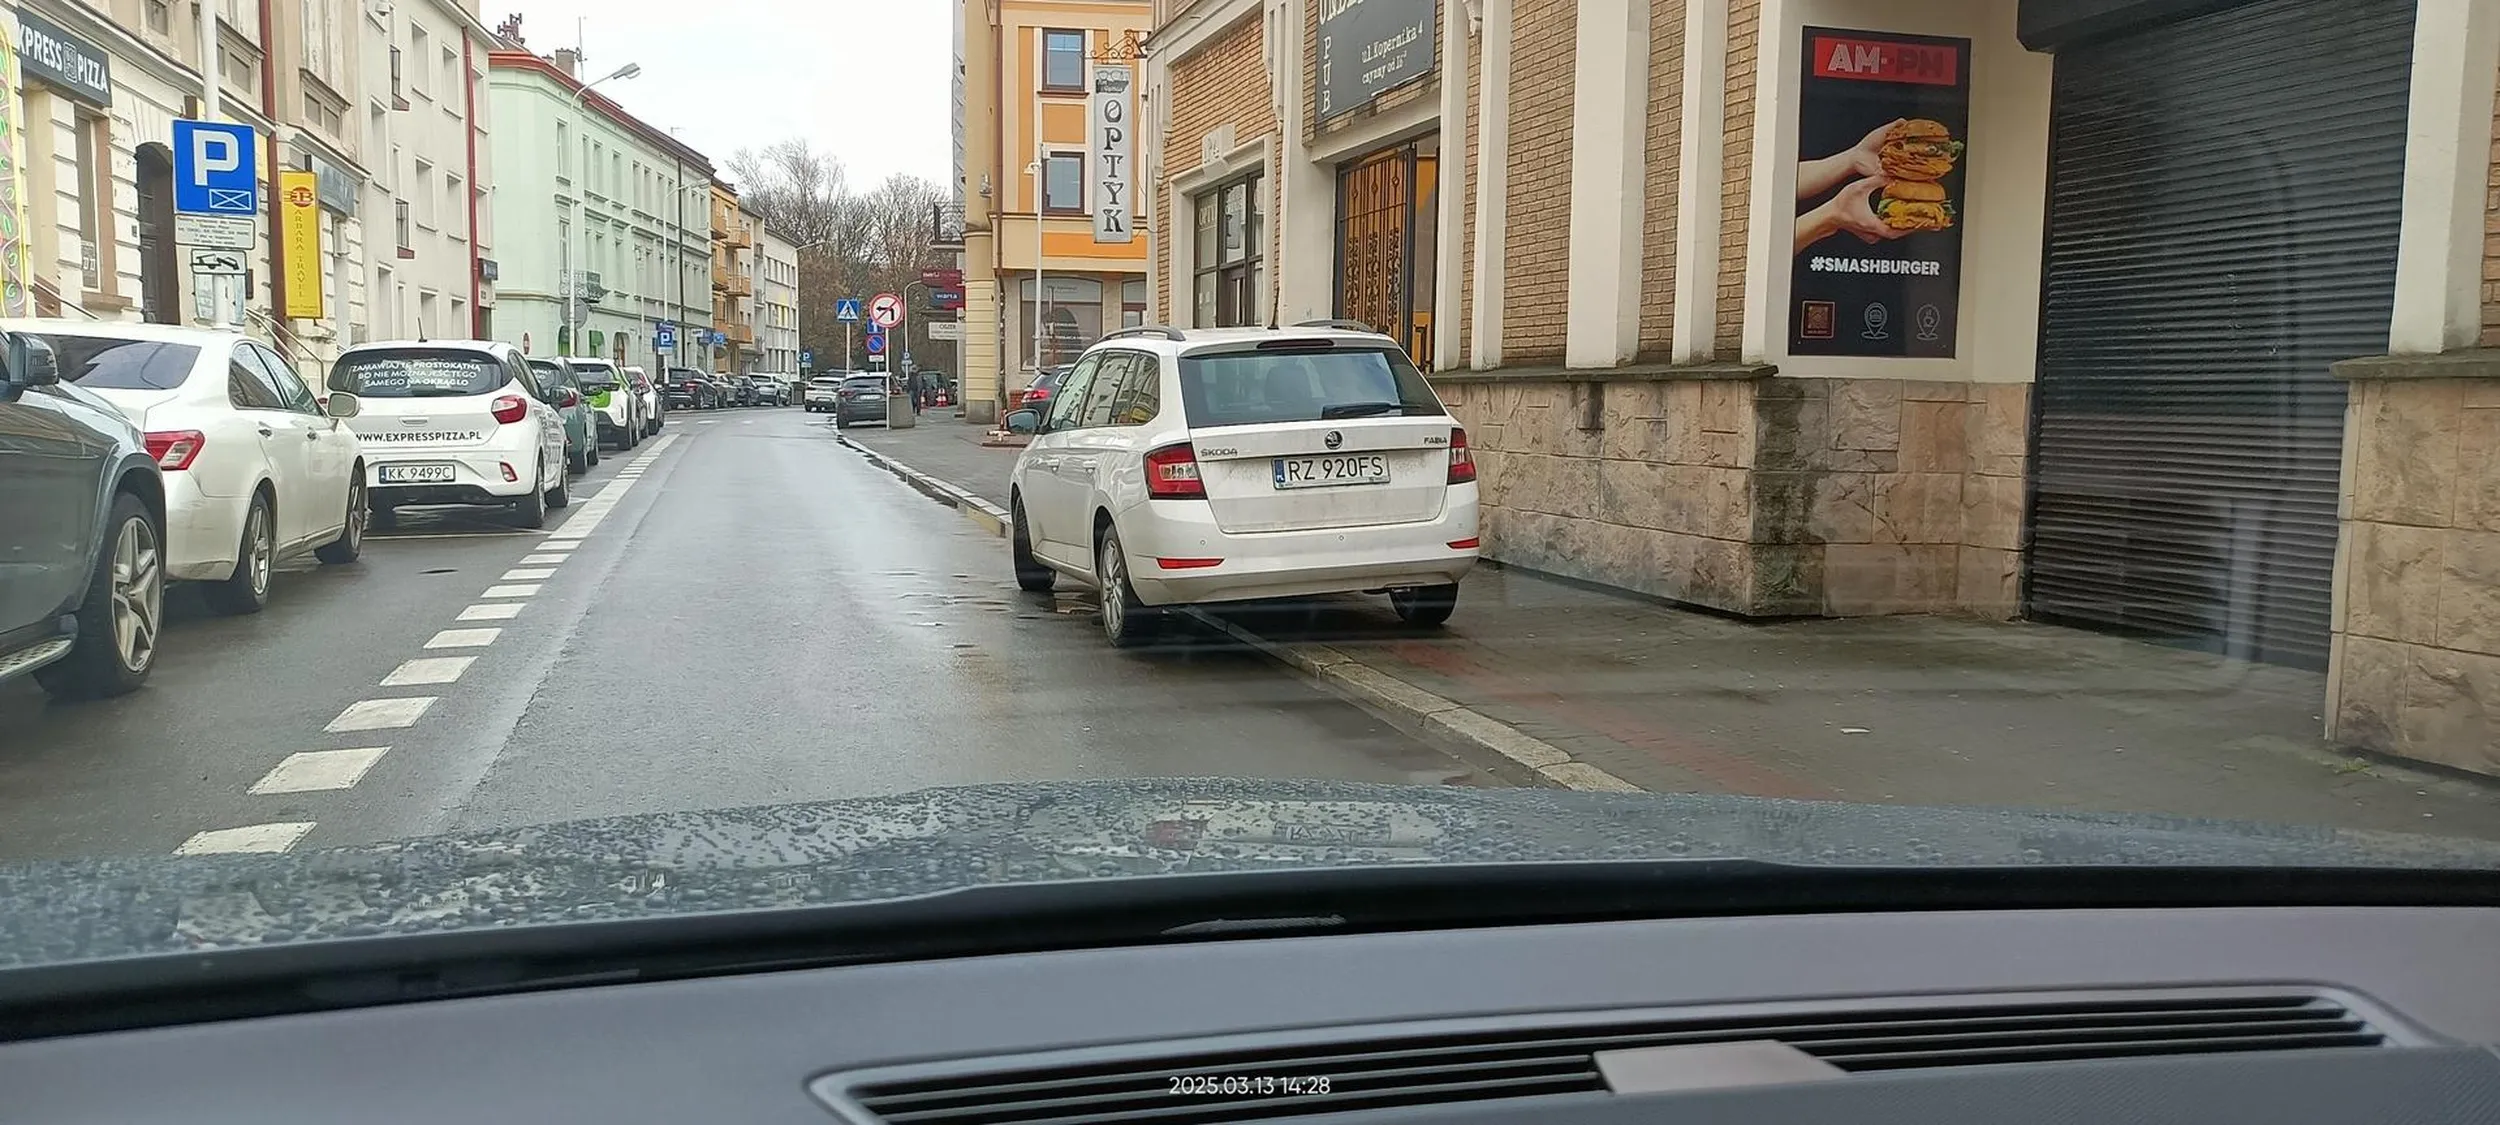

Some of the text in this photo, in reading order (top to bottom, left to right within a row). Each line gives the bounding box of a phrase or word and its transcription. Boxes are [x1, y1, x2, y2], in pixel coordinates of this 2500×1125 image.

[1417, 19, 1423, 34] 4
[77, 53, 109, 94] PIZZA
[1321, 35, 1332, 114] PUB
[1361, 64, 1386, 84] czynny
[1387, 57, 1395, 73] od
[192, 129, 240, 186] P
[1102, 99, 1124, 233] OPTYK
[1810, 256, 1940, 276] #SMASHBURGER
[660, 332, 670, 345] P
[452, 370, 477, 378] TEGO
[364, 379, 405, 388] SAMEGO
[356, 431, 482, 442] WWW.EXPRESSPIZZA.PL
[1423, 436, 1448, 445] FABIA
[388, 467, 451, 479] KK 9499C
[1288, 460, 1316, 481] RZ
[1322, 457, 1384, 479] 920FS
